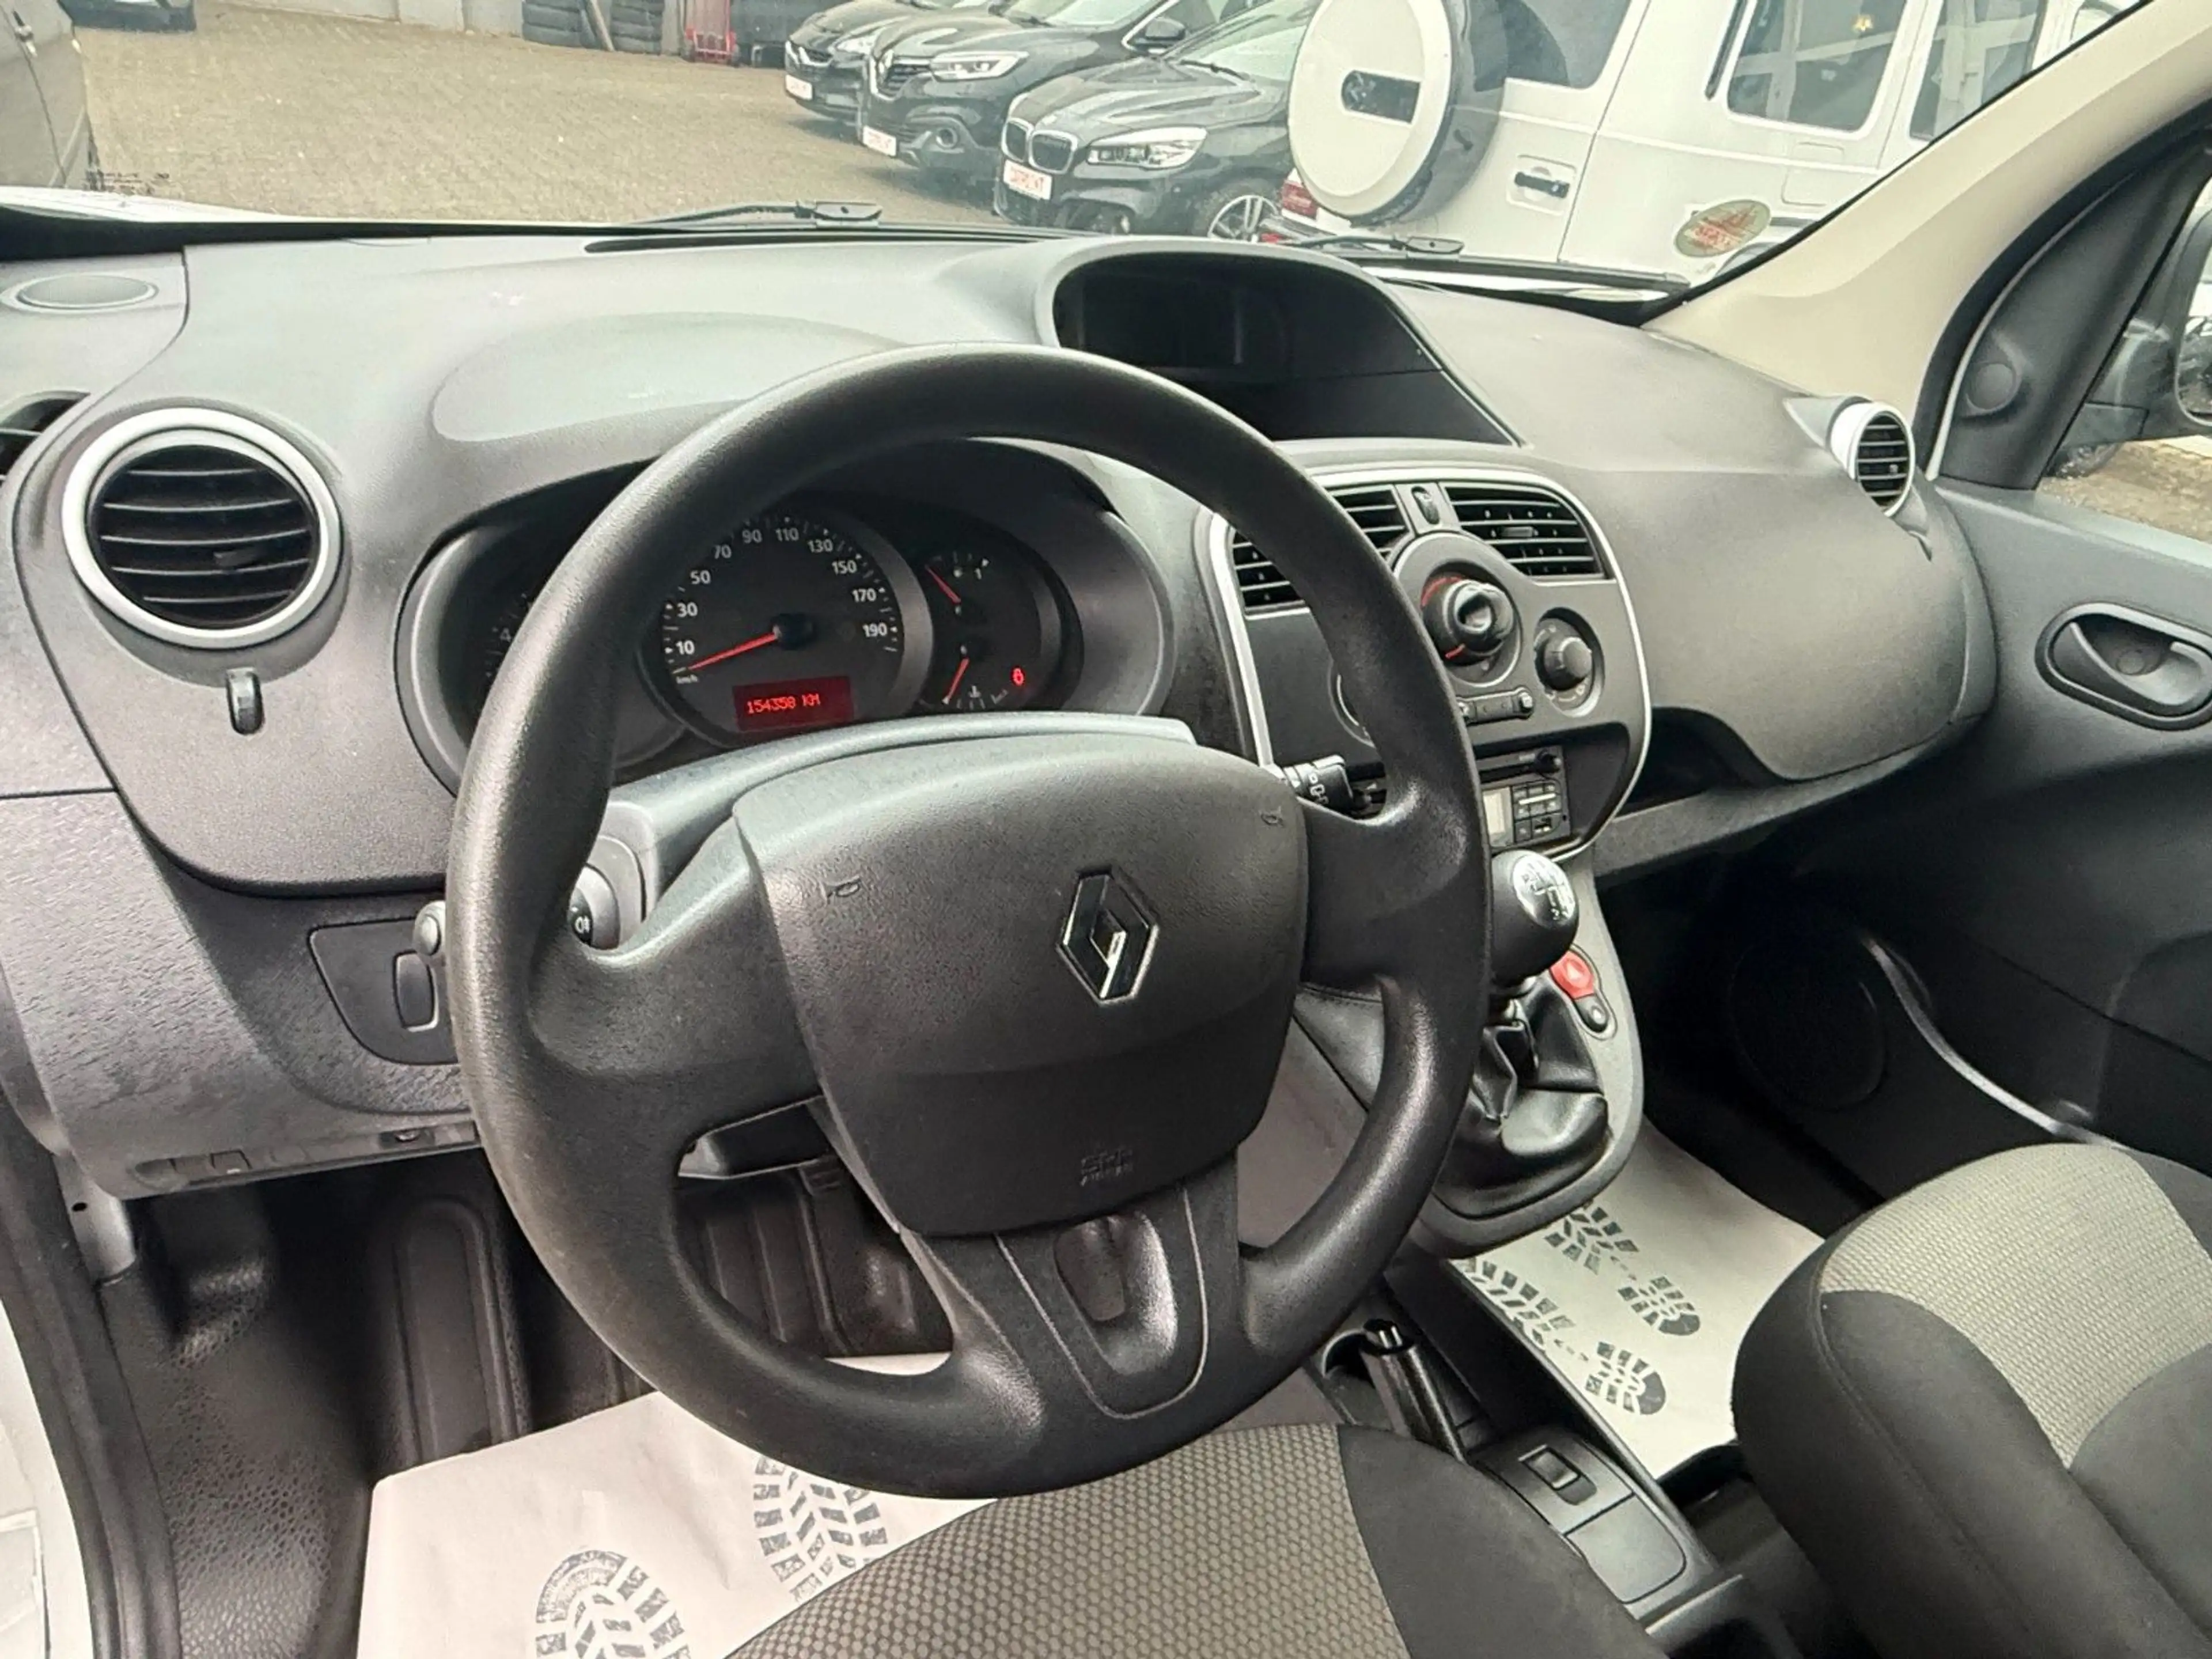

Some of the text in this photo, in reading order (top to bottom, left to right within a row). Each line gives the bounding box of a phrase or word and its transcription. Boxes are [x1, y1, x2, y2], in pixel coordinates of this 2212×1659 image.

[742, 529, 763, 544] 90
[776, 528, 800, 541] 110
[714, 544, 732, 559] 70
[808, 539, 834, 553] 130
[831, 559, 858, 575] 150
[690, 569, 711, 585] 50
[852, 588, 877, 603] 170
[677, 602, 699, 618] 30
[862, 622, 888, 637] 190
[676, 640, 695, 655] 10
